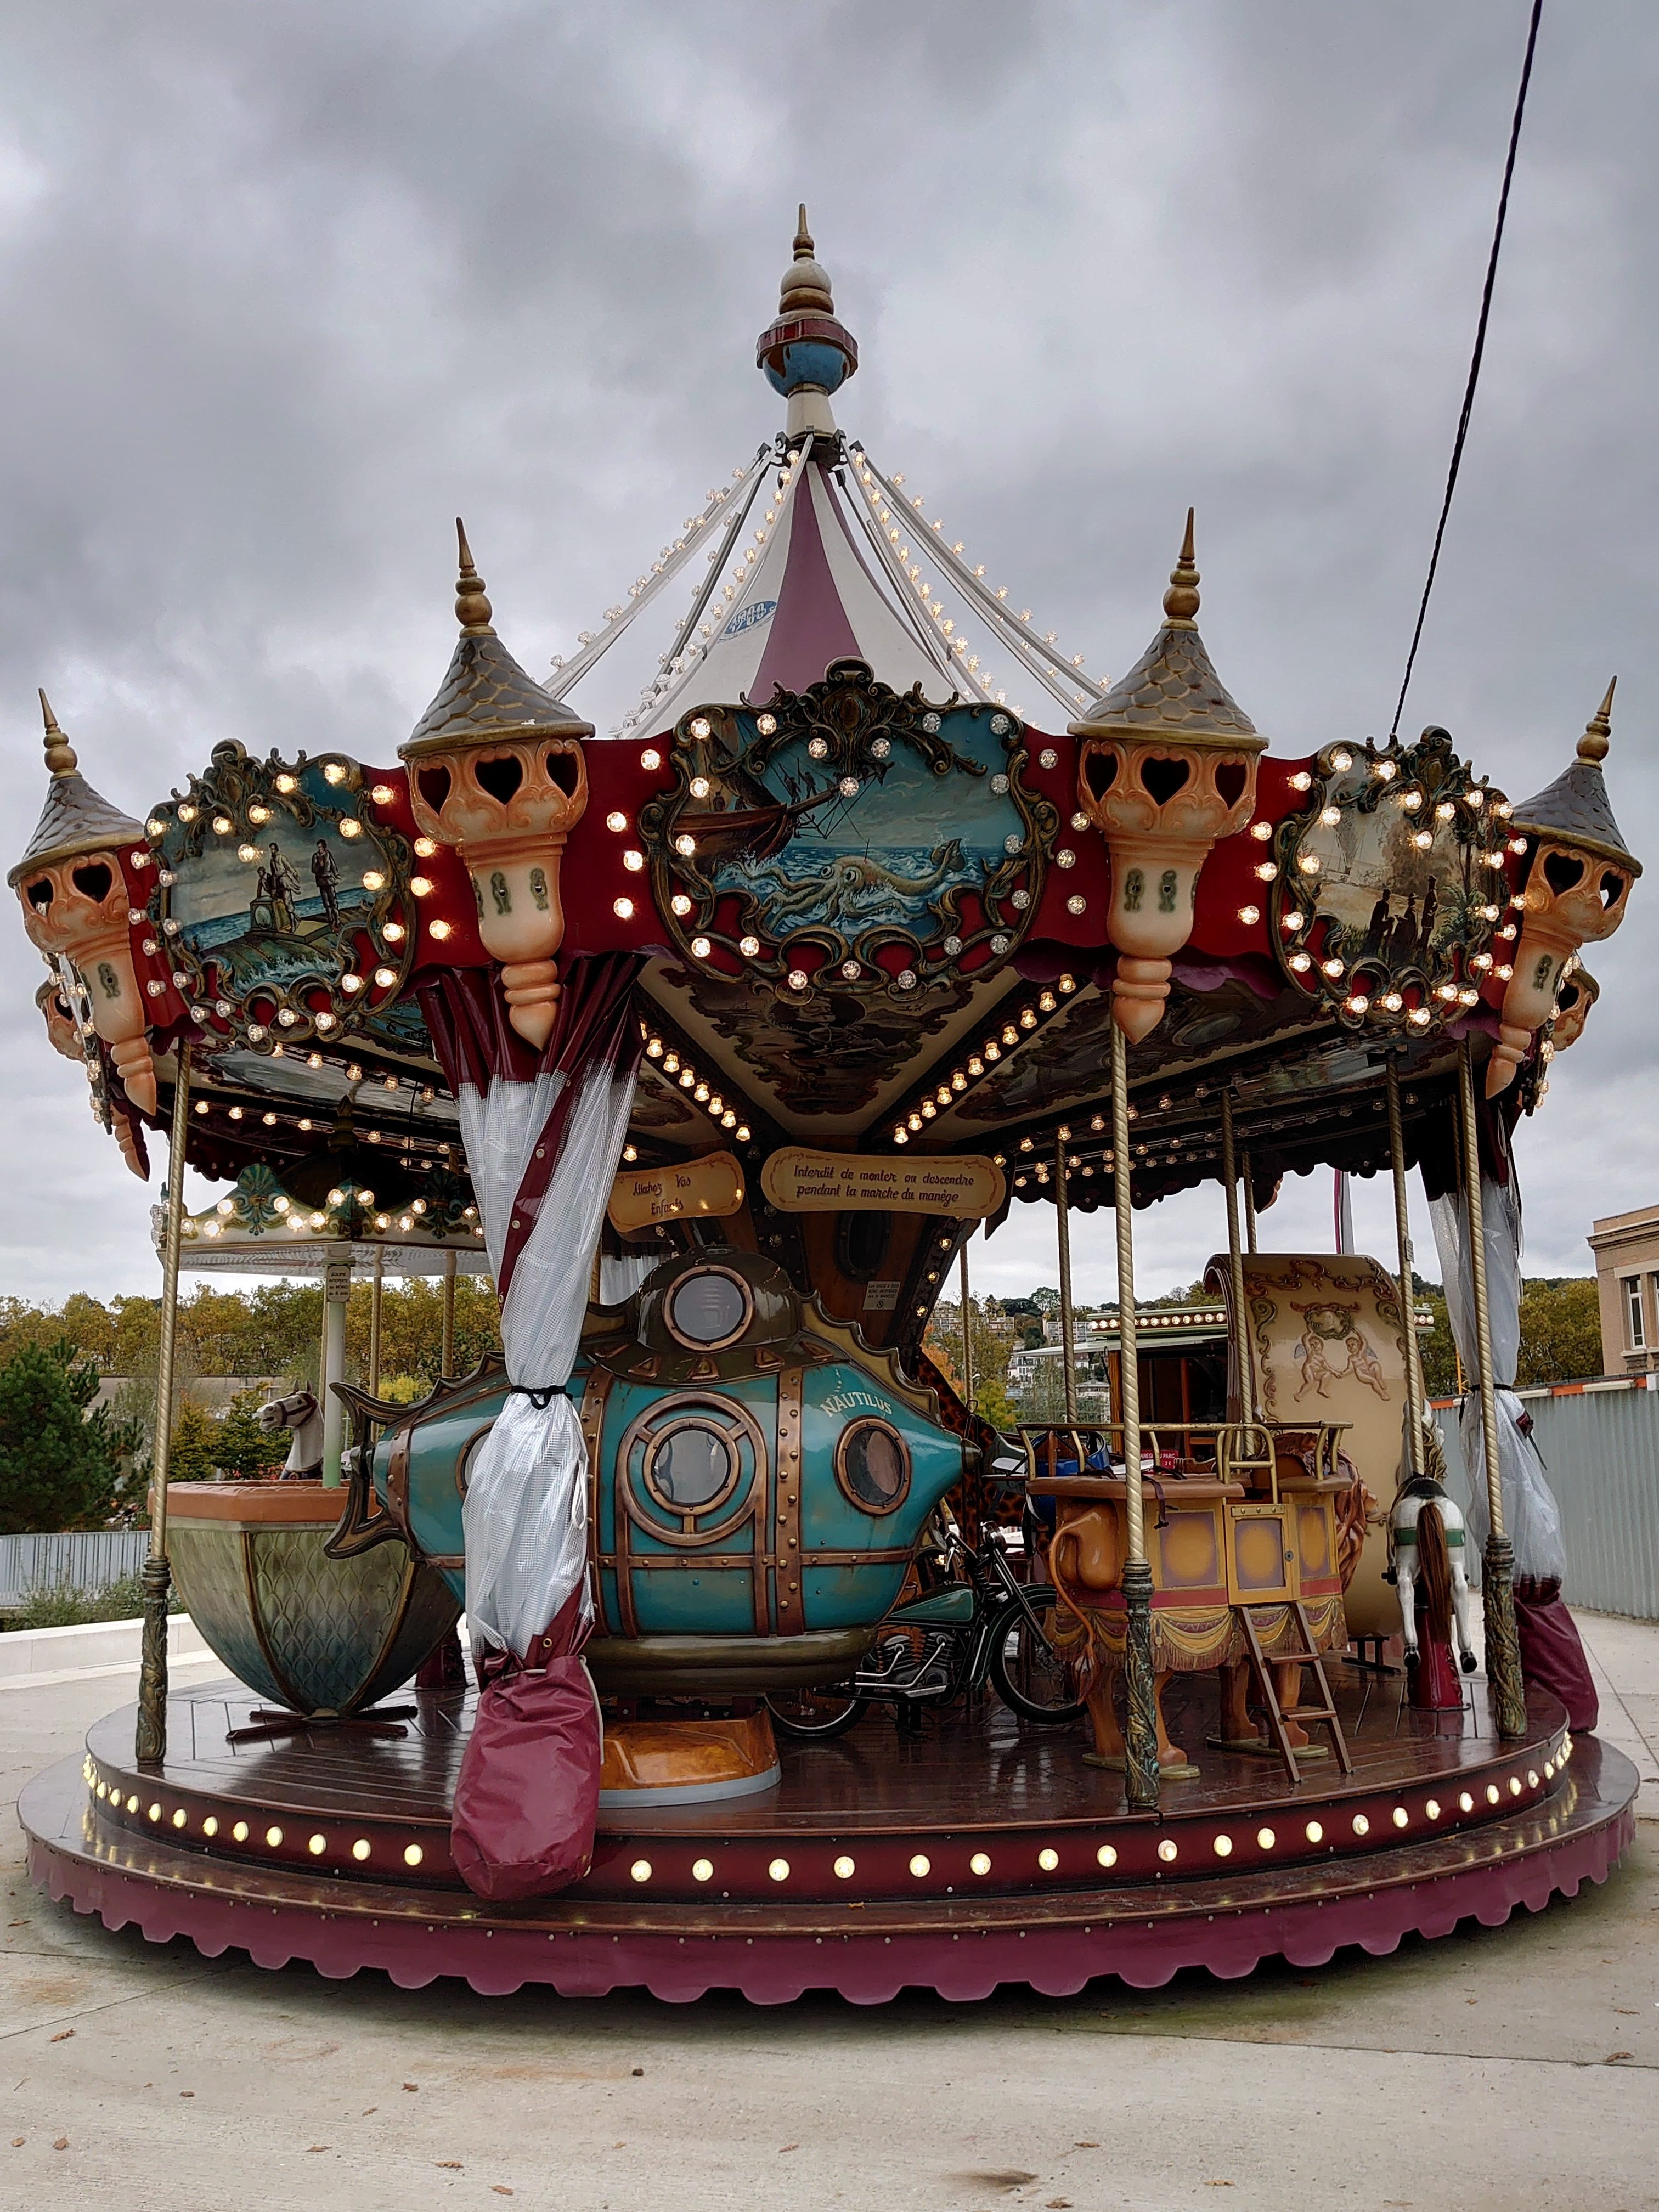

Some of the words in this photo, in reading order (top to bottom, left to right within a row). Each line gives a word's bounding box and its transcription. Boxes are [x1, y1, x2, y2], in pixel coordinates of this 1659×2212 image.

[633, 1181, 662, 1196] Attachez
[675, 1174, 691, 1188] Vos
[794, 1165, 834, 1179] Interdit
[840, 1167, 854, 1180] de
[860, 1170, 897, 1182] monter
[905, 1175, 917, 1183] ou
[922, 1172, 974, 1185] descendre
[797, 1183, 841, 1198] pendant
[846, 1184, 856, 1197] la
[860, 1186, 899, 1199] marche
[901, 1187, 914, 1200] du
[919, 1189, 959, 1207] manège
[820, 1392, 892, 1417] NAUTILUS
